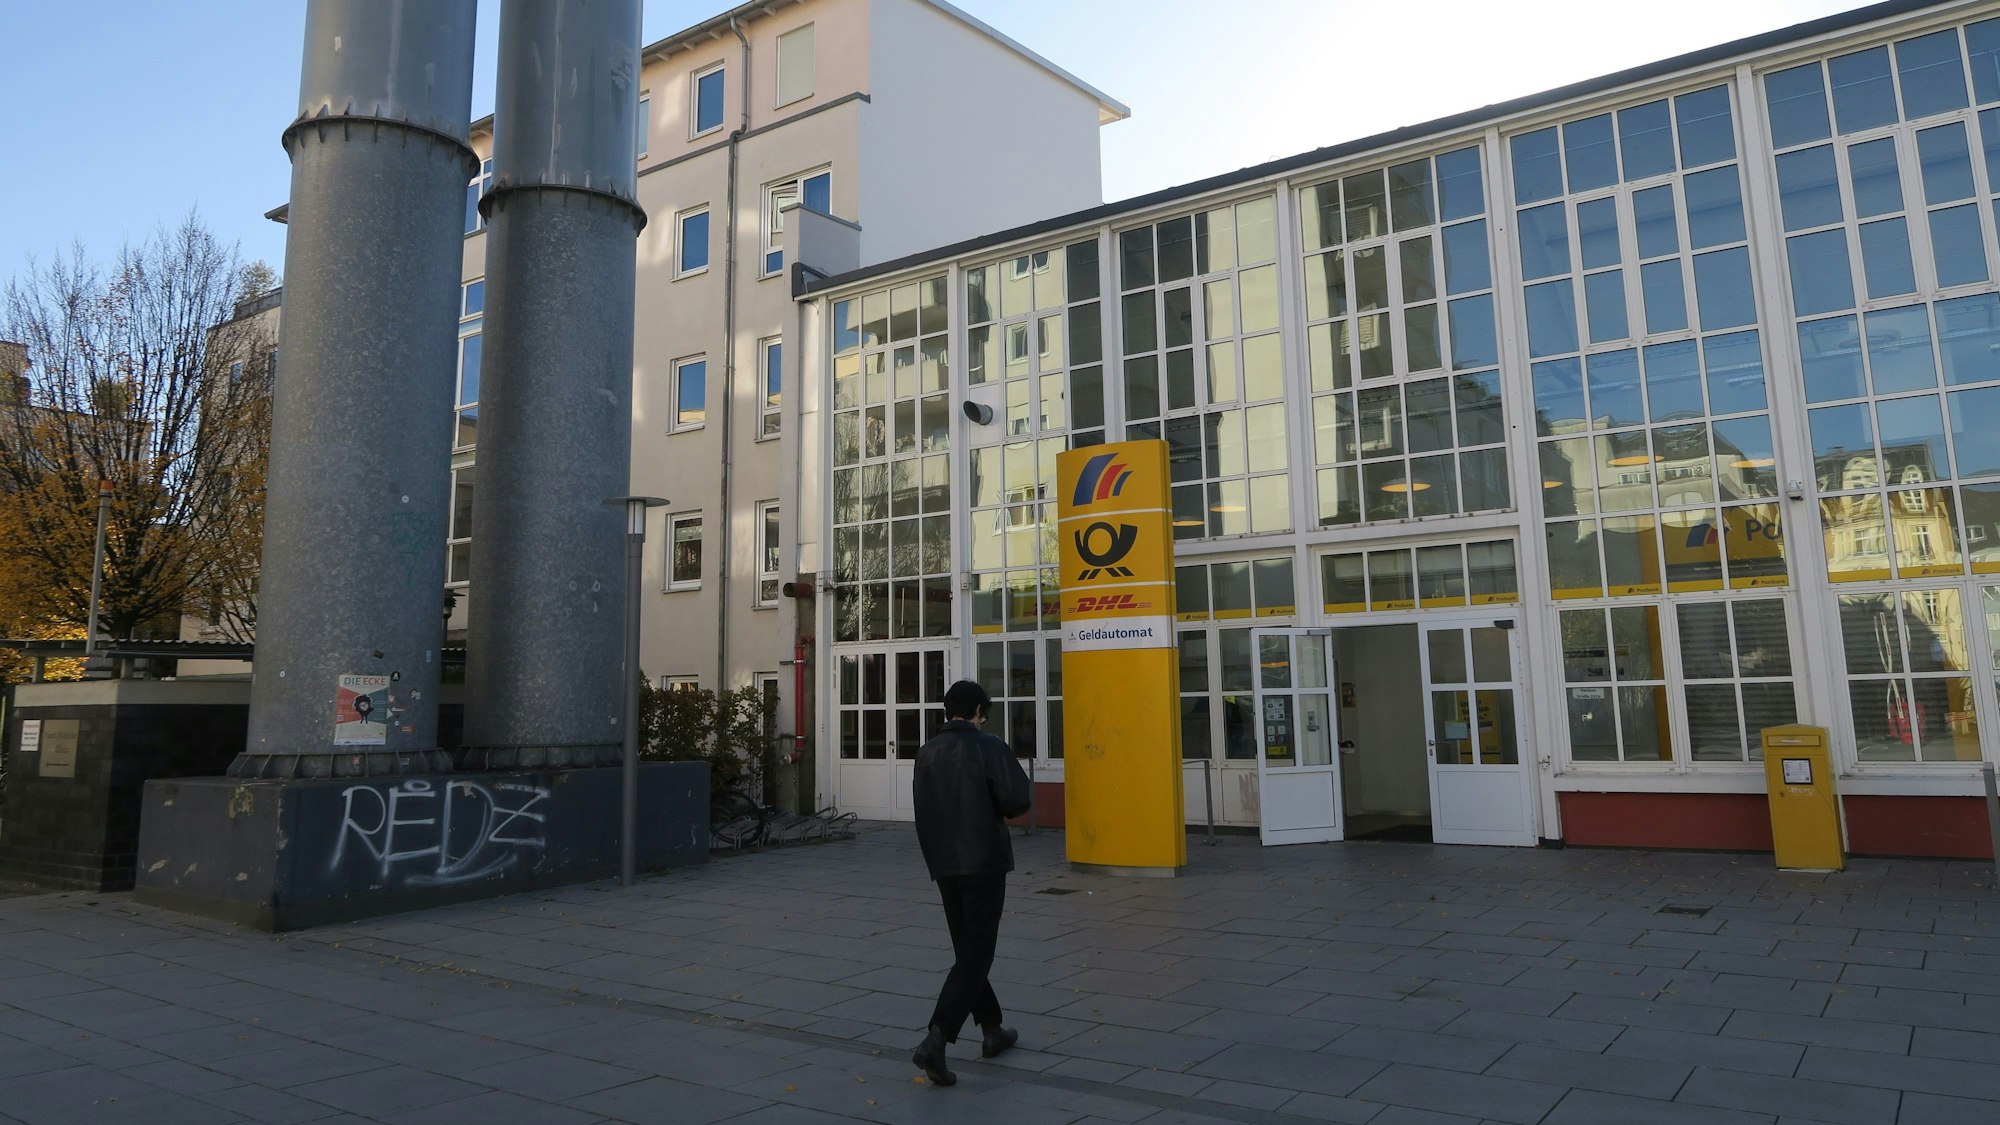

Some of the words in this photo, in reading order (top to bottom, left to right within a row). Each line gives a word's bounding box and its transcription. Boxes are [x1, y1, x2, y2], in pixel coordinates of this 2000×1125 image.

[1076, 594, 1144, 613] DHL
[1078, 626, 1153, 641] Geldautomat
[344, 677, 361, 686] DIE
[362, 677, 386, 686] ECKE
